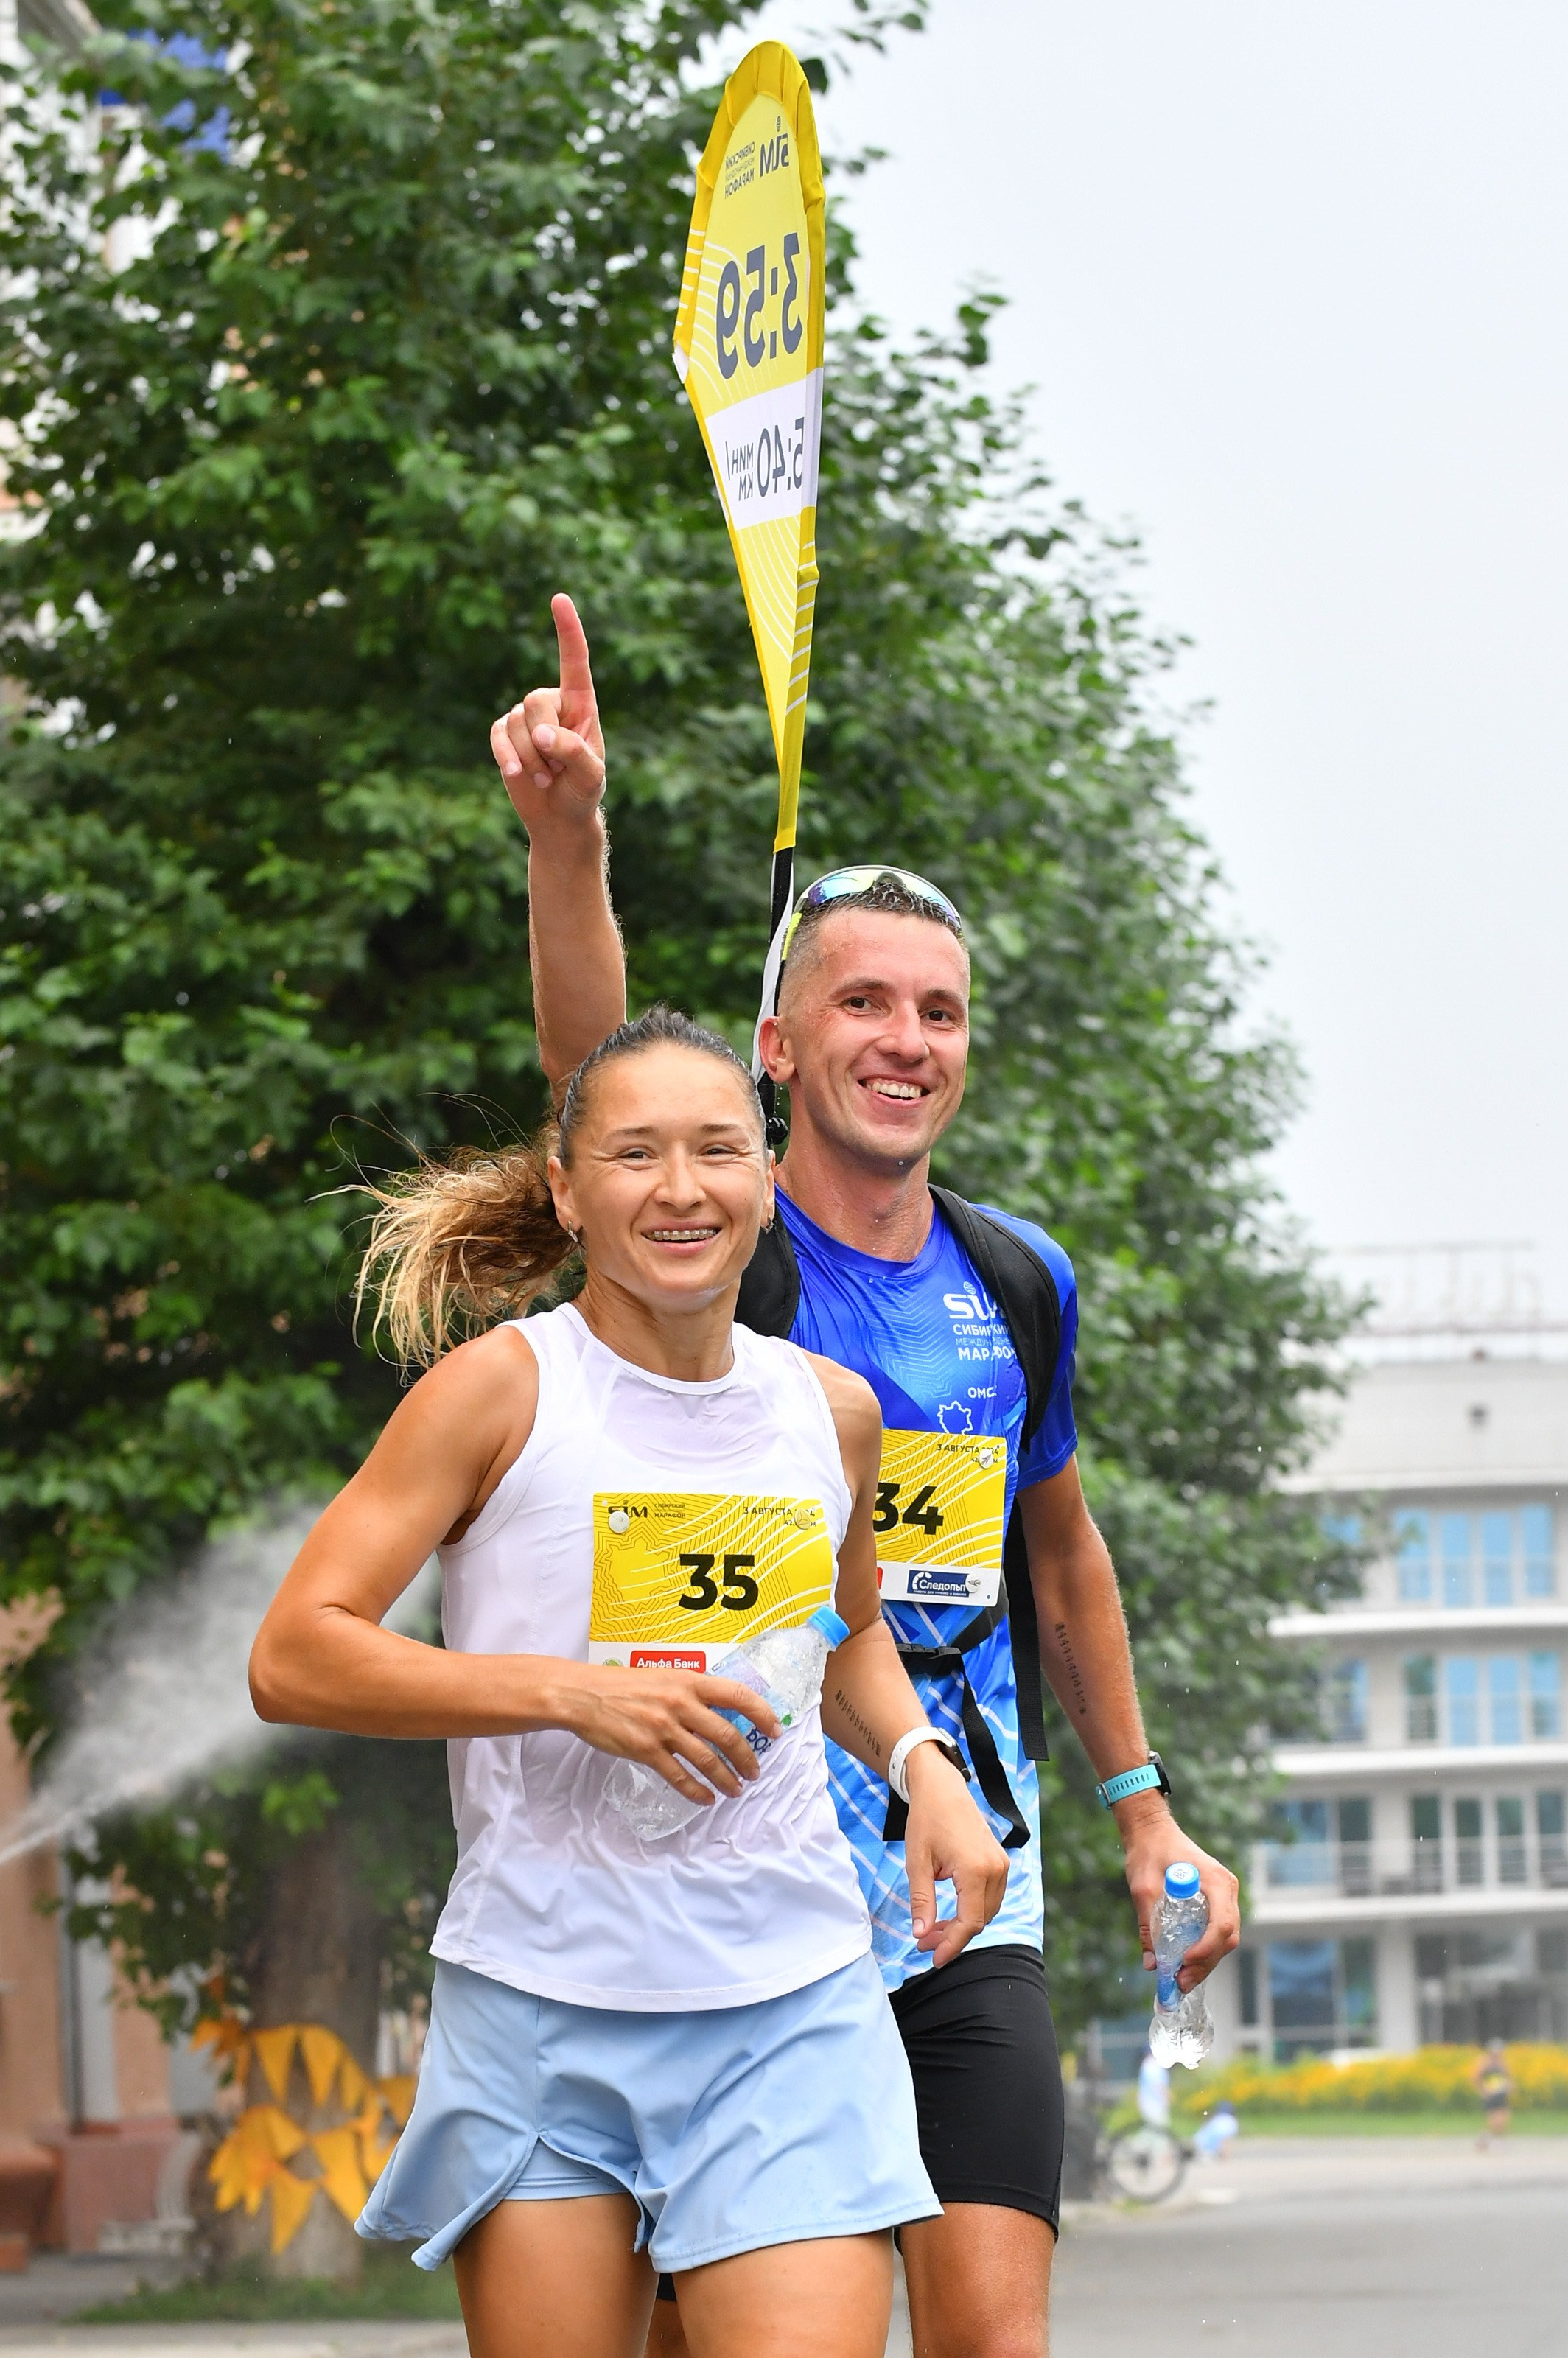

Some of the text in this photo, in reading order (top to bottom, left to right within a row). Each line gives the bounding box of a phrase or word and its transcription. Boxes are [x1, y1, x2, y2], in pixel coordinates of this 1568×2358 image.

[967, 1386, 997, 1399] ОМС
[944, 1445, 980, 1454] АВГУСТА
[751, 1507, 793, 1516] АВГУСТА
[872, 1482, 944, 1536] 34
[678, 1553, 759, 1611] 35
[636, 1657, 701, 1669] Альфа Банк
